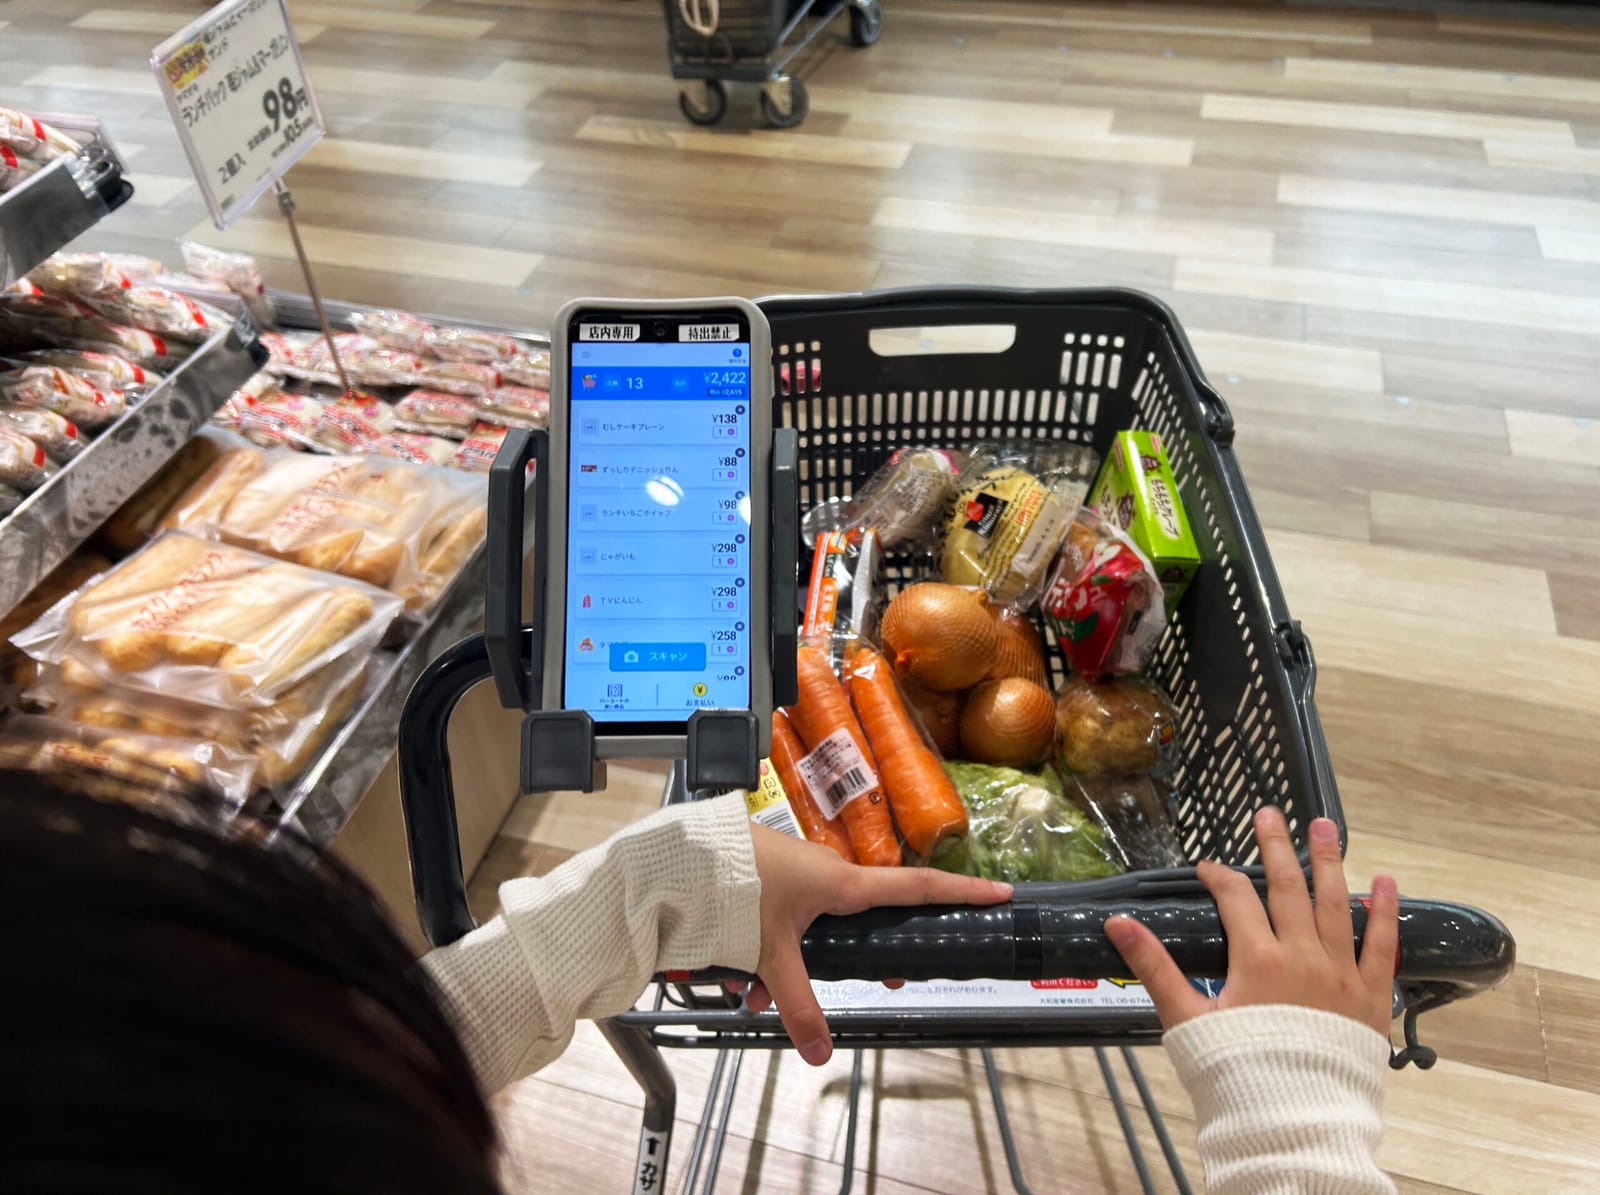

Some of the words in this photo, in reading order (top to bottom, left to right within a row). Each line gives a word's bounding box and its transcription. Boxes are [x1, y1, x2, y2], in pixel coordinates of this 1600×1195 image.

[181, 76, 228, 128] ランチパック
[217, 152, 248, 185] 2個入
[589, 325, 634, 340] 店内専用
[688, 325, 732, 340] 持出禁止
[626, 377, 644, 390] 13
[703, 371, 747, 387] ¥2,422
[712, 413, 737, 424] ¥138
[602, 422, 665, 432] むしケーキプレーン
[718, 456, 737, 467] ¥88
[602, 465, 679, 474] ずっしりデニッシュりん
[718, 499, 737, 510] ¥98
[602, 508, 672, 518] ランチいちごホイップ
[711, 543, 737, 553] ¥298
[600, 551, 636, 561] じゃがいも
[711, 586, 737, 597] ¥298
[711, 630, 737, 641] ¥258
[648, 651, 688, 662] スキャン
[686, 698, 715, 707] お支払い
[639, 1161, 658, 1191] カサ
